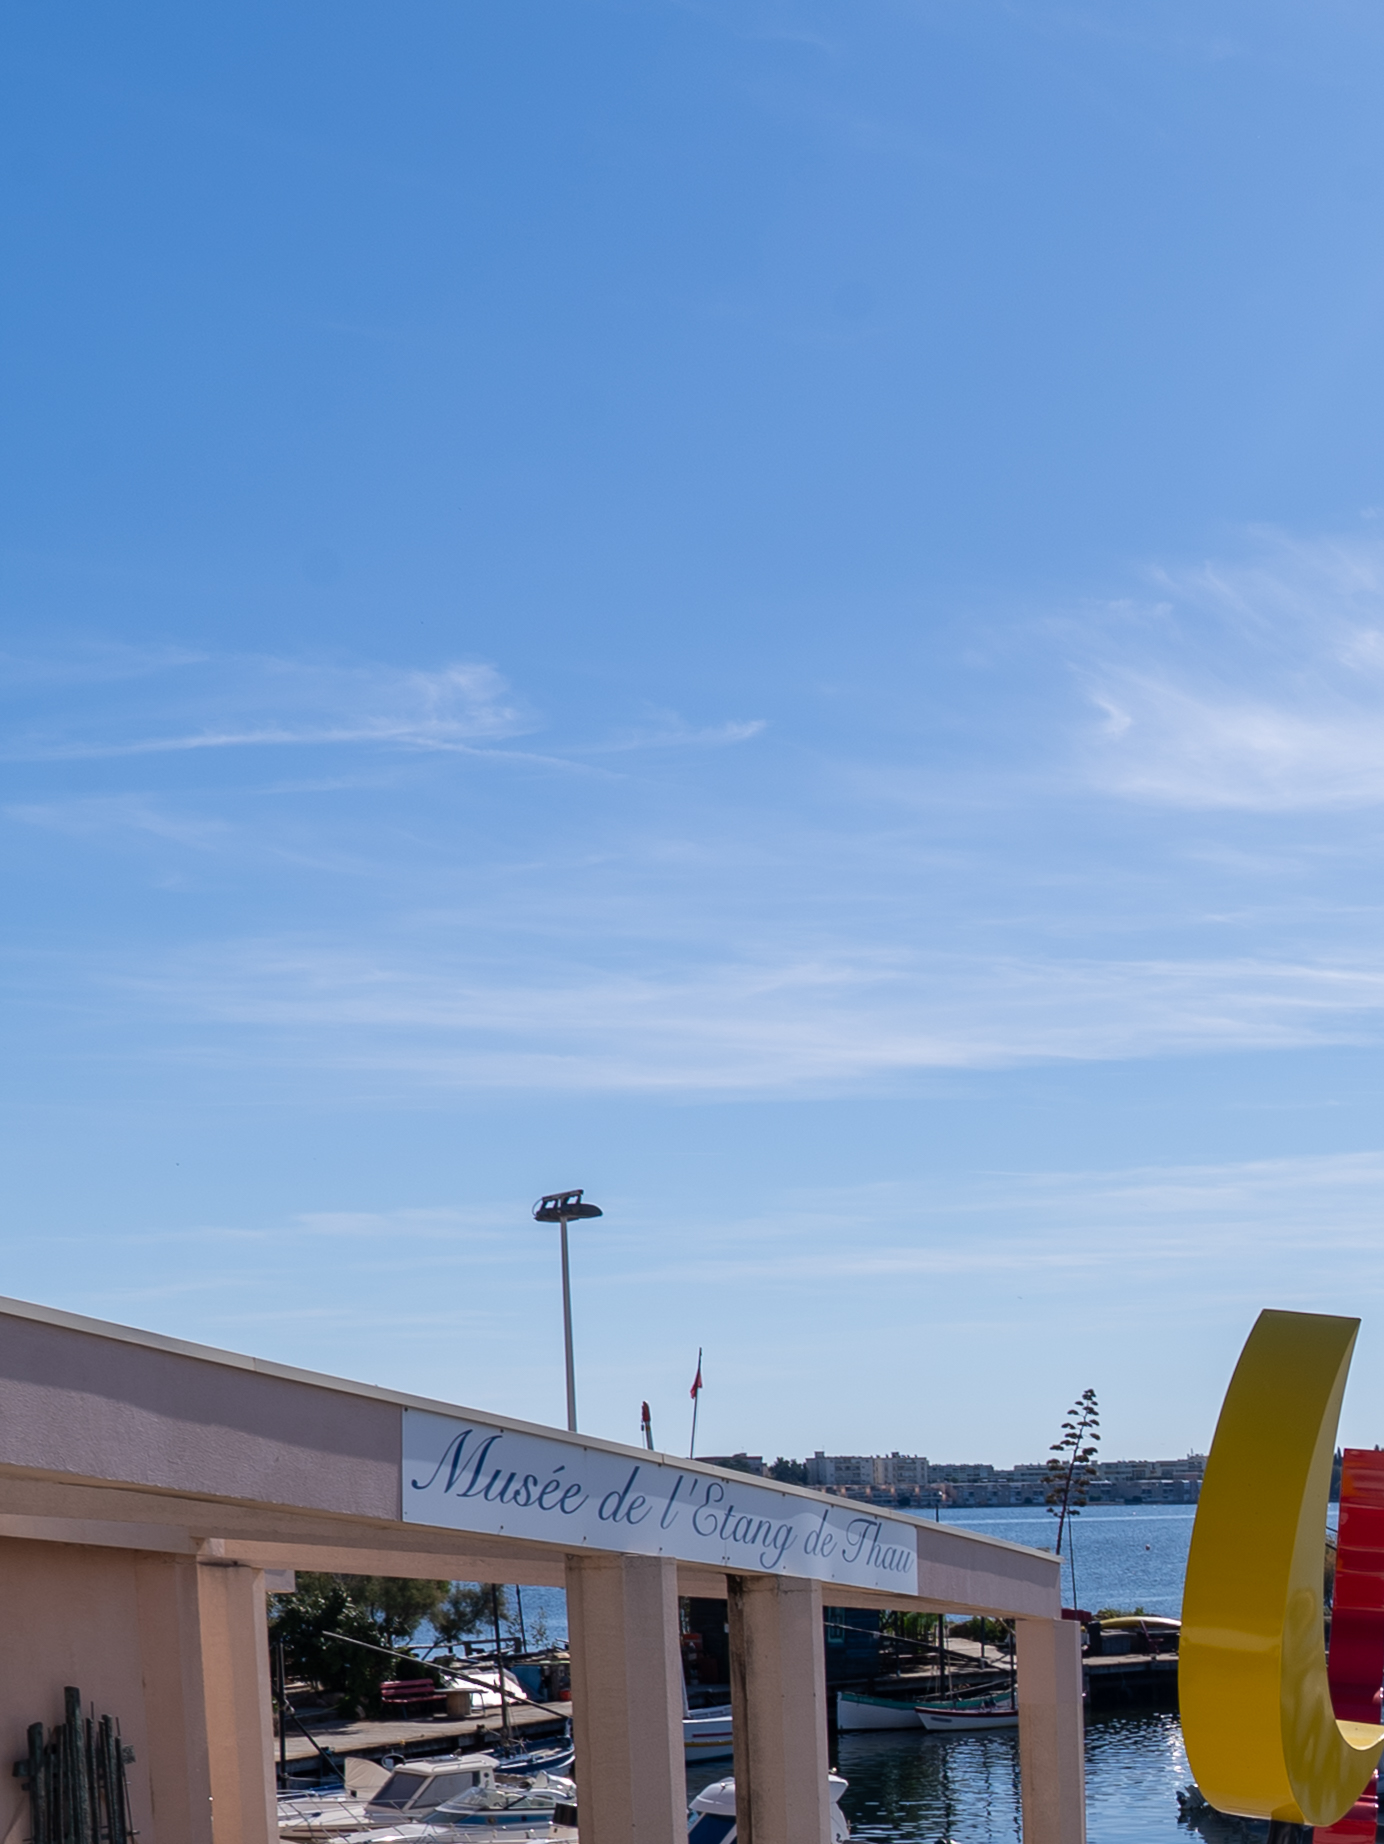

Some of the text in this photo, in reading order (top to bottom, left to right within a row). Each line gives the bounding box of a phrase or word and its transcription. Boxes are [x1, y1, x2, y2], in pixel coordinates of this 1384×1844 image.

[412, 1428, 589, 1514] Musée
[598, 1465, 653, 1525] de
[804, 1508, 838, 1557] de
[842, 1518, 914, 1574] Thau
